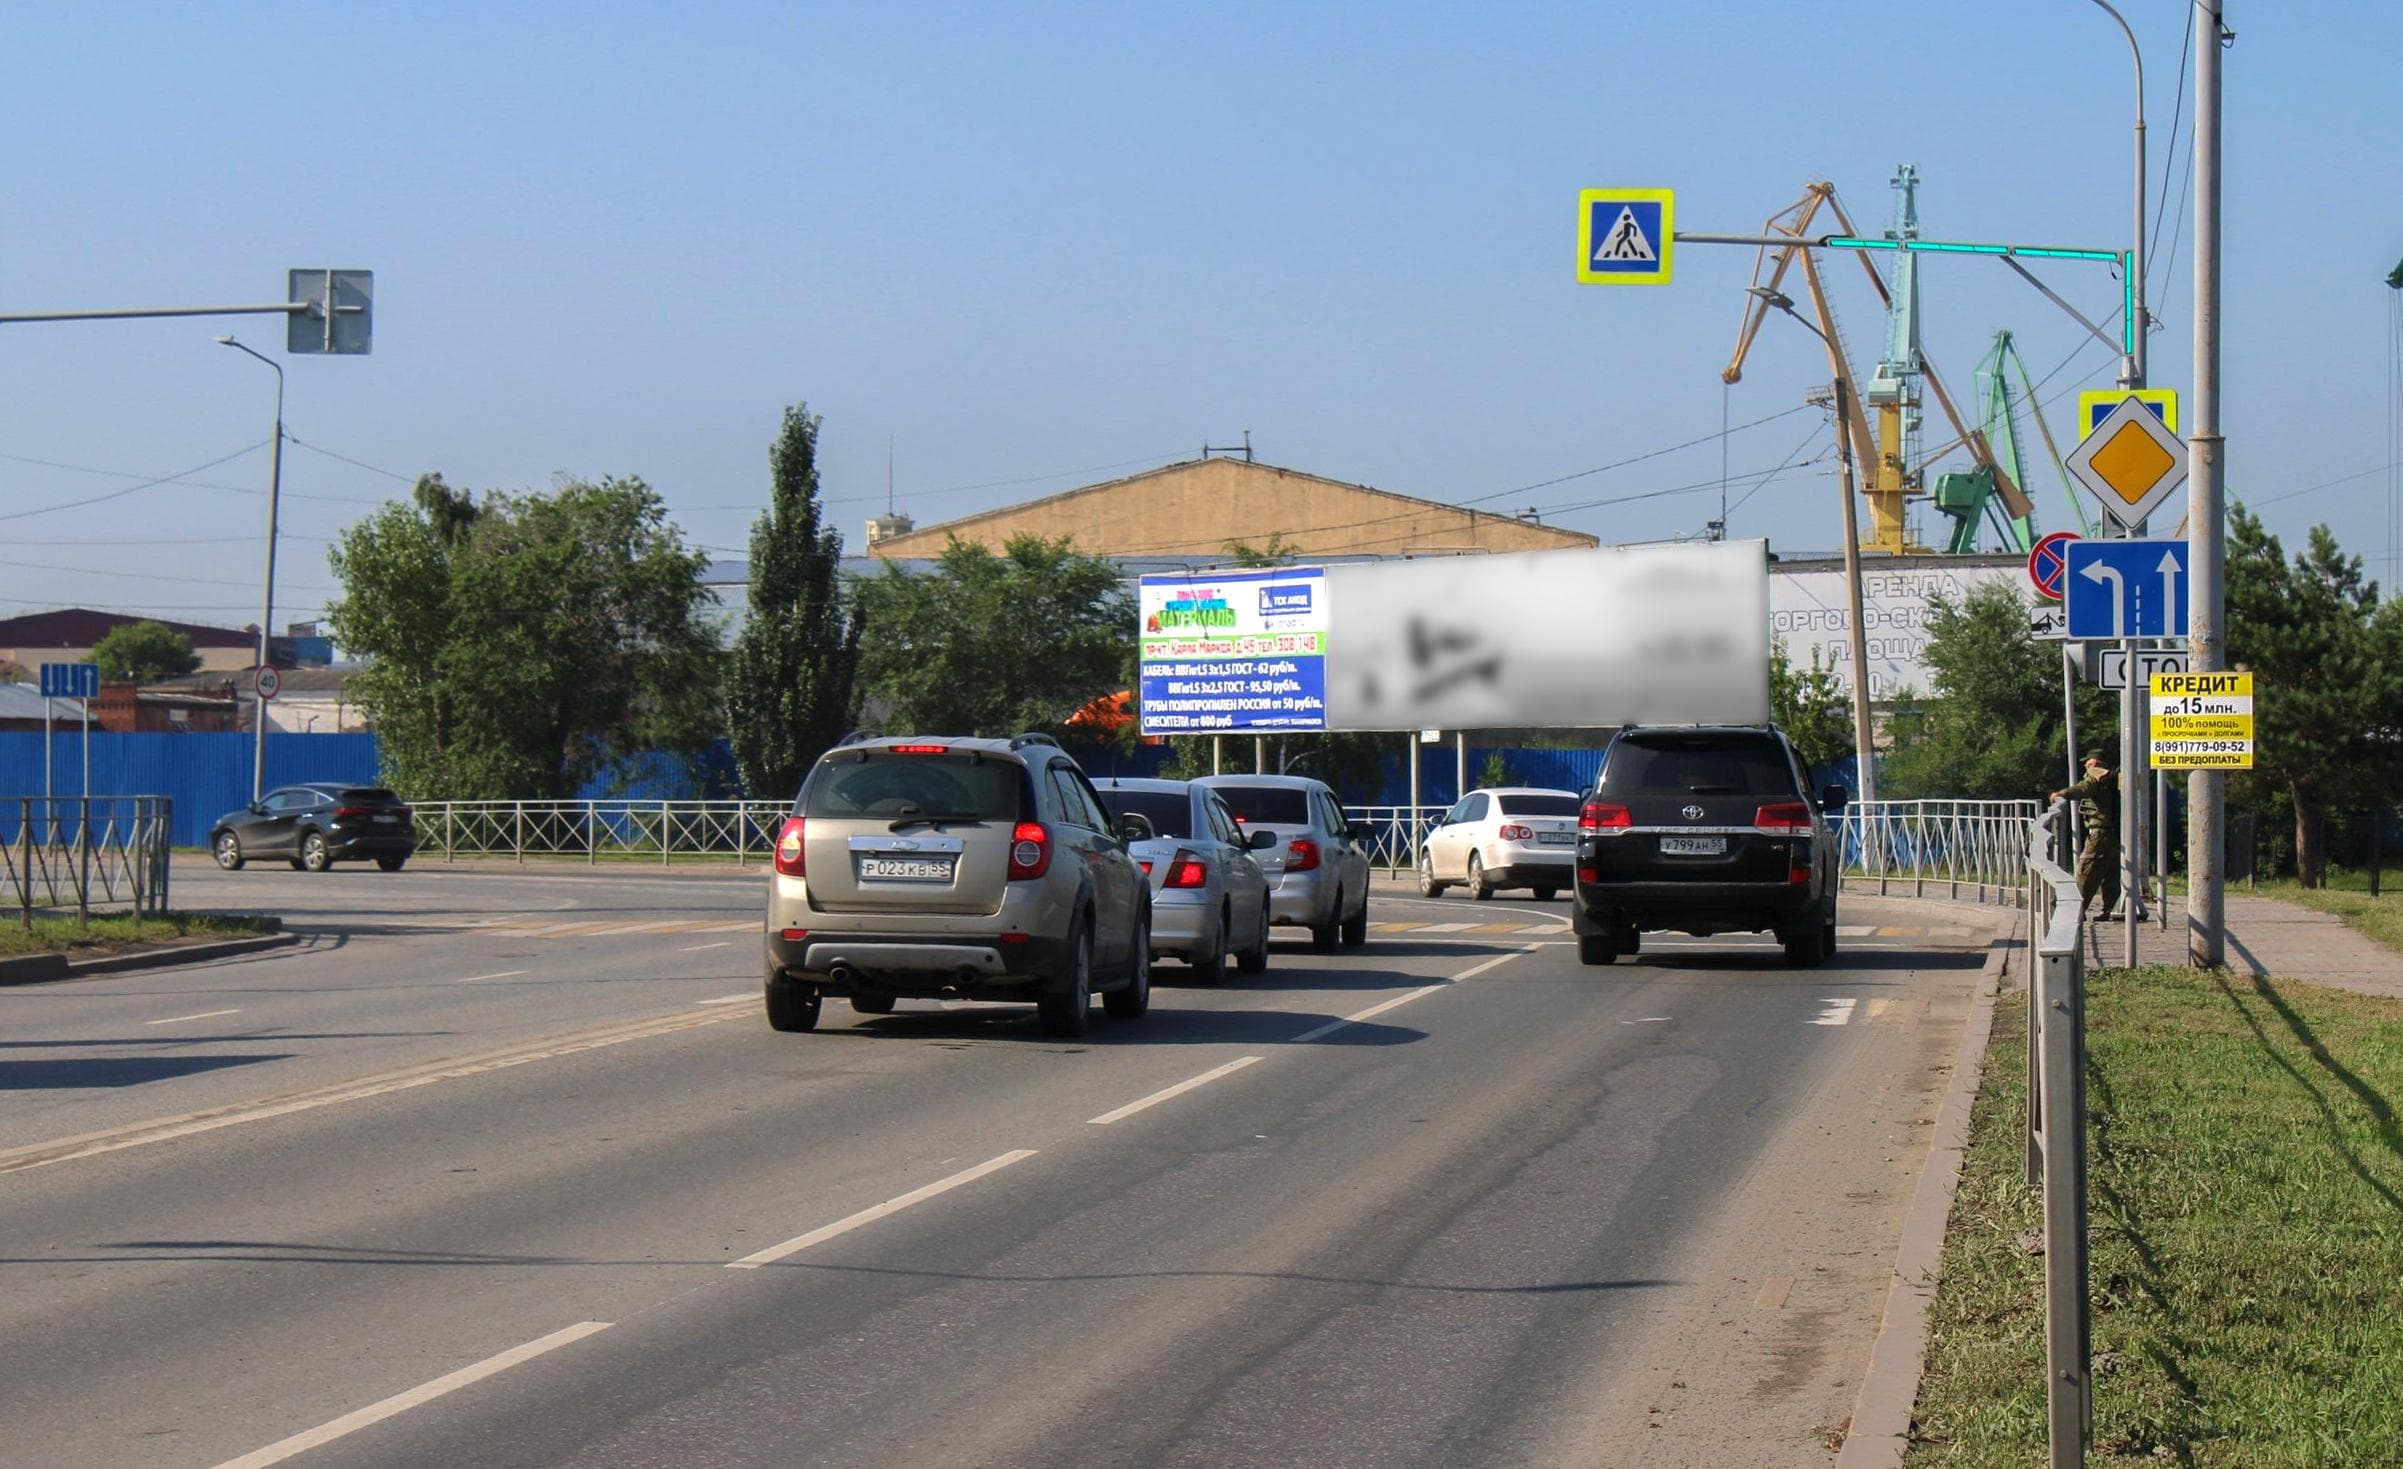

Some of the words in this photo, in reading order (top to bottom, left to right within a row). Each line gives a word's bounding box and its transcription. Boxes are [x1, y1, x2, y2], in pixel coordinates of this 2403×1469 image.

[1232, 664, 1252, 675] ГОСТ
[260, 675, 276, 689] 40
[1224, 682, 1244, 693] ГОСТ
[2162, 676, 2239, 694] КРЕДИТ
[1144, 700, 1168, 712] ТРУБЫ
[1238, 698, 1272, 710] РОССИЯ
[1272, 700, 1282, 709] от
[1283, 698, 1294, 709] 50
[2164, 705, 2179, 715] до
[2180, 697, 2202, 714] 15
[2205, 705, 2237, 714] млн.
[1190, 718, 1200, 727] от
[1216, 714, 1232, 728] руб
[2161, 717, 2194, 728] 100%
[2196, 720, 2239, 728] помощь
[2154, 741, 2245, 754] 8(991)779-09-52
[2159, 756, 2176, 764] БЕЗ
[2178, 756, 2240, 764] ПРЕДОПЛАТЫ
[1711, 840, 1723, 848] 55
[931, 861, 947, 873] 55
